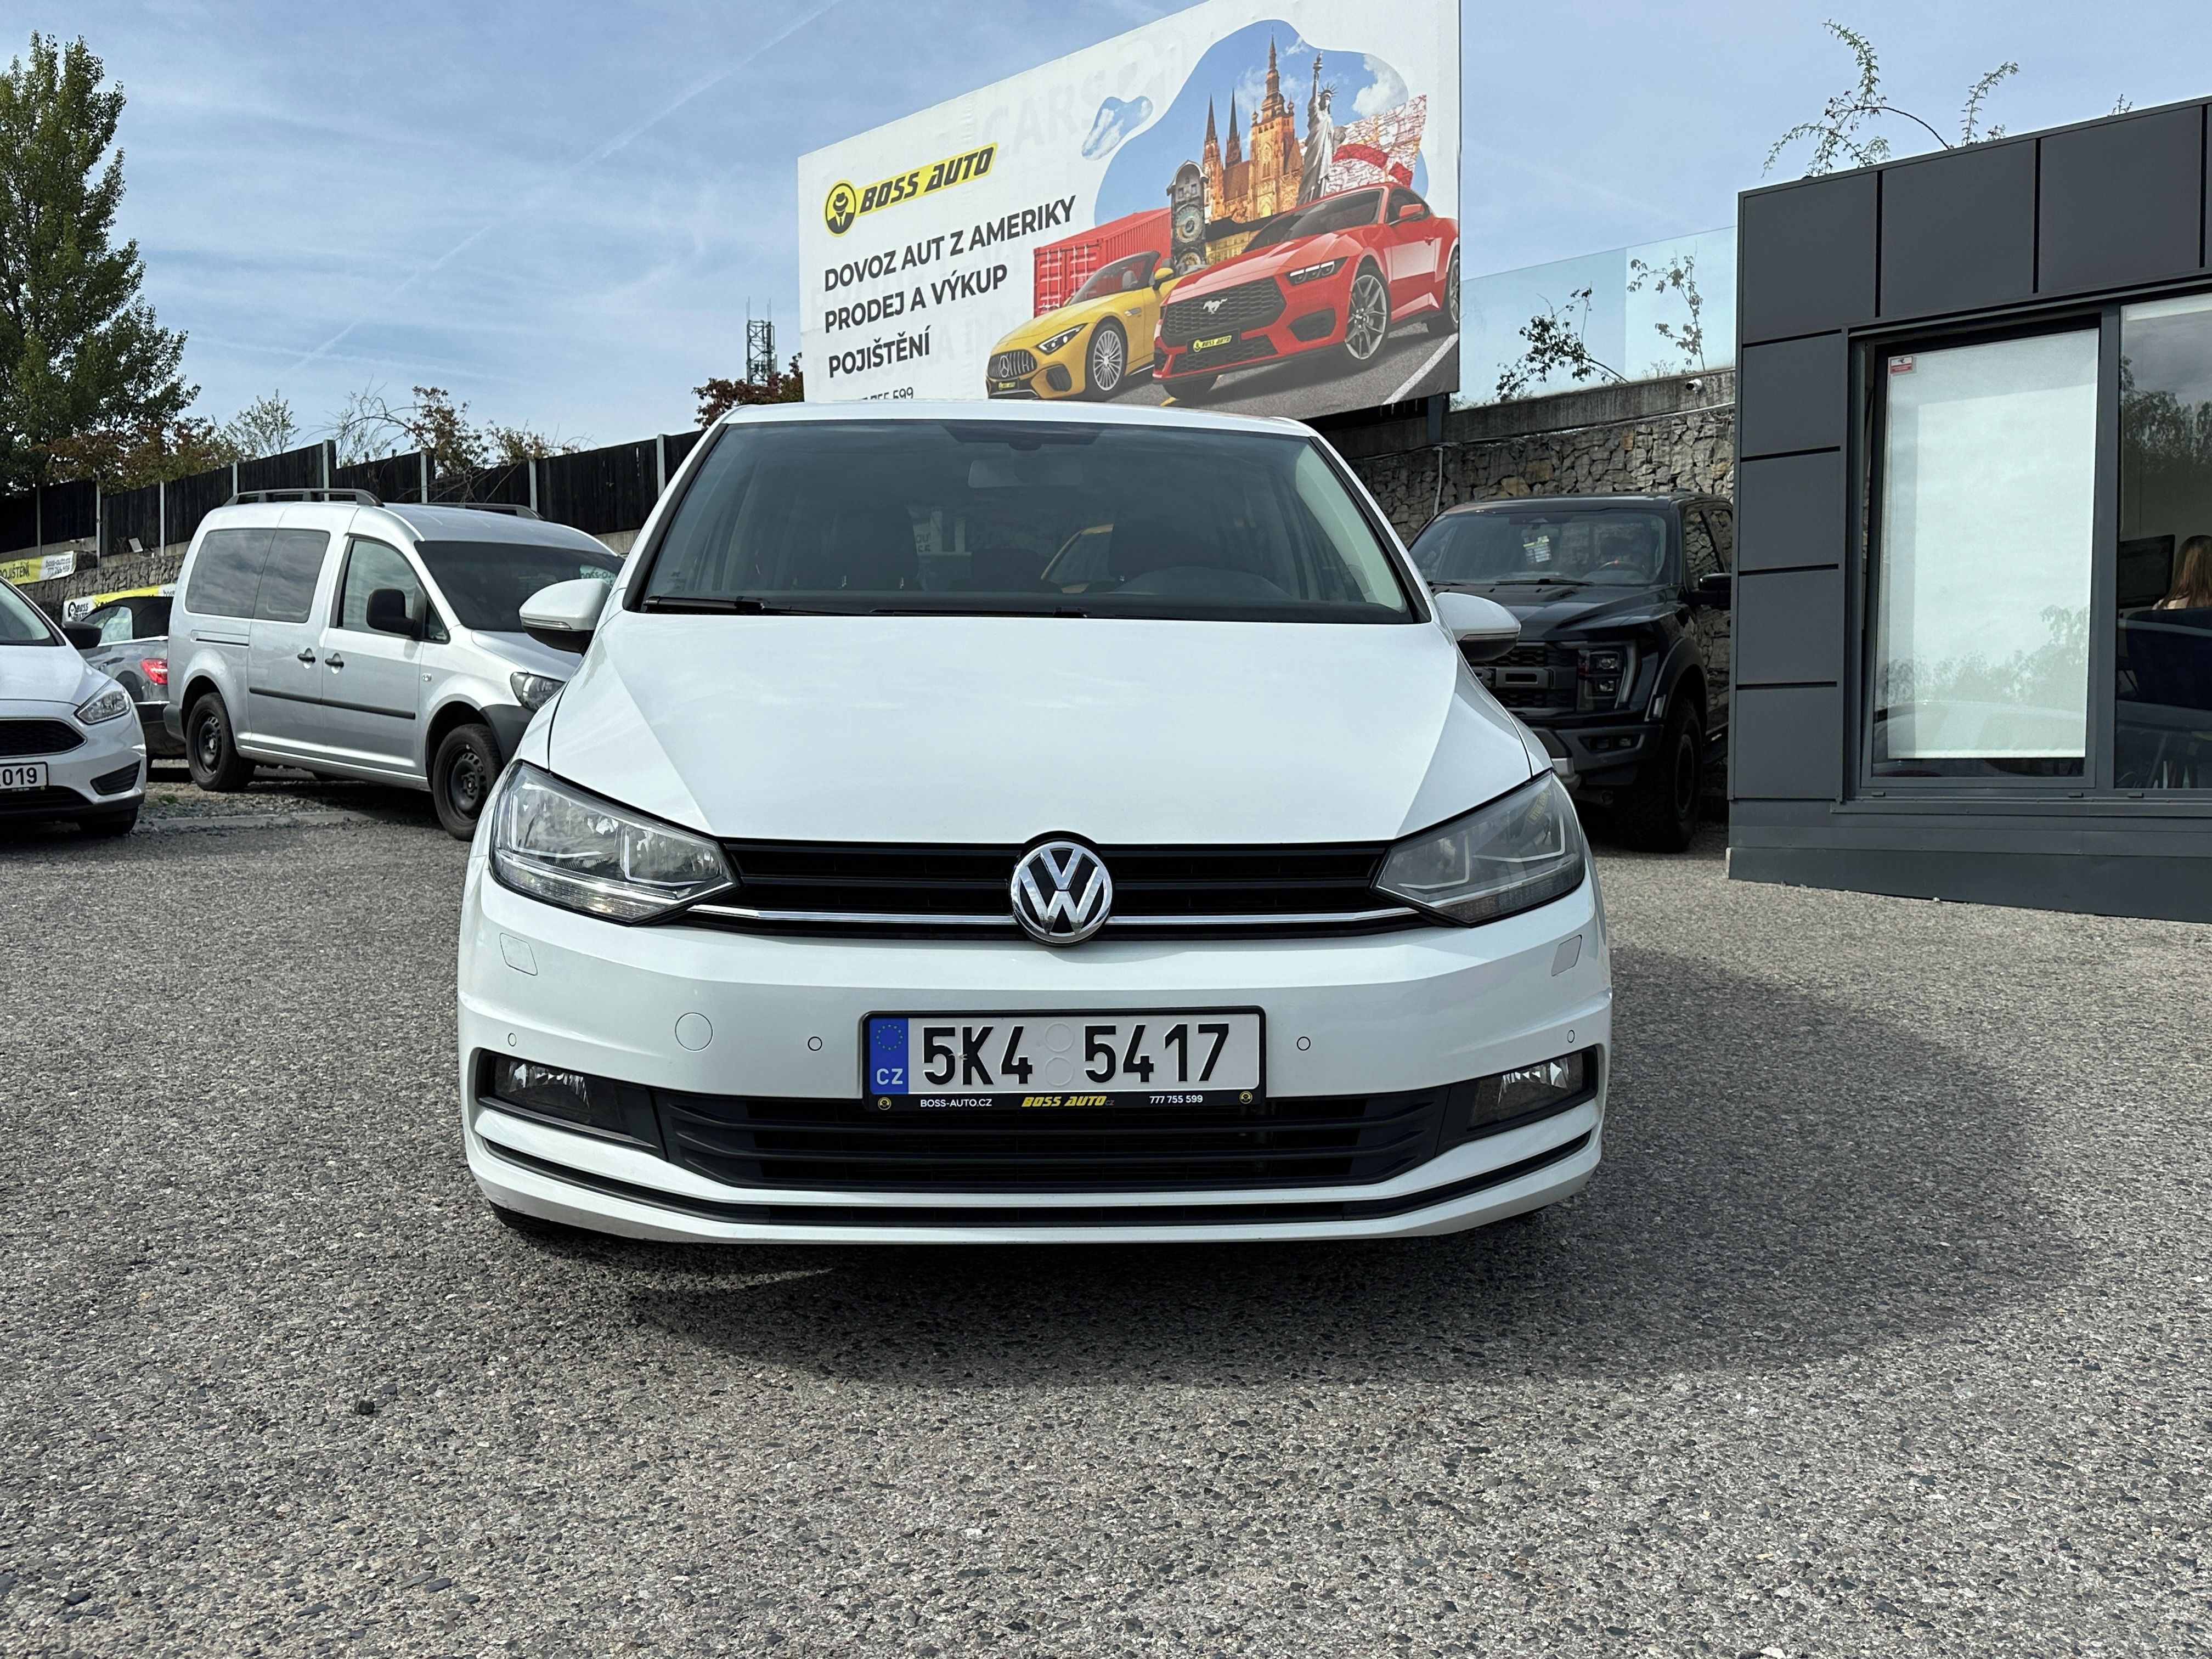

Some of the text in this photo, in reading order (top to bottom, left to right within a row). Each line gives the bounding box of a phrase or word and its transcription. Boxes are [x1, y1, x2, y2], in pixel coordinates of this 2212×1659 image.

[859, 147, 994, 213] BOSS AUTO
[825, 195, 1076, 292] DOVOZ AUT Z AMERIKY
[825, 264, 1008, 334] PRODEJ A VÝKUP
[828, 325, 932, 378] POJIŠTĚNÍ
[0, 560, 30, 580] OJIŠTĚNÍ
[0, 767, 37, 787] 019
[923, 1023, 1229, 1086] 5K4 5417
[876, 1068, 904, 1085] CZ
[920, 1098, 992, 1108] BOSS-AUTO.CZ
[1021, 1096, 1062, 1108] BOSS
[1149, 1096, 1166, 1104] 777
[1185, 1094, 1203, 1103] 599
